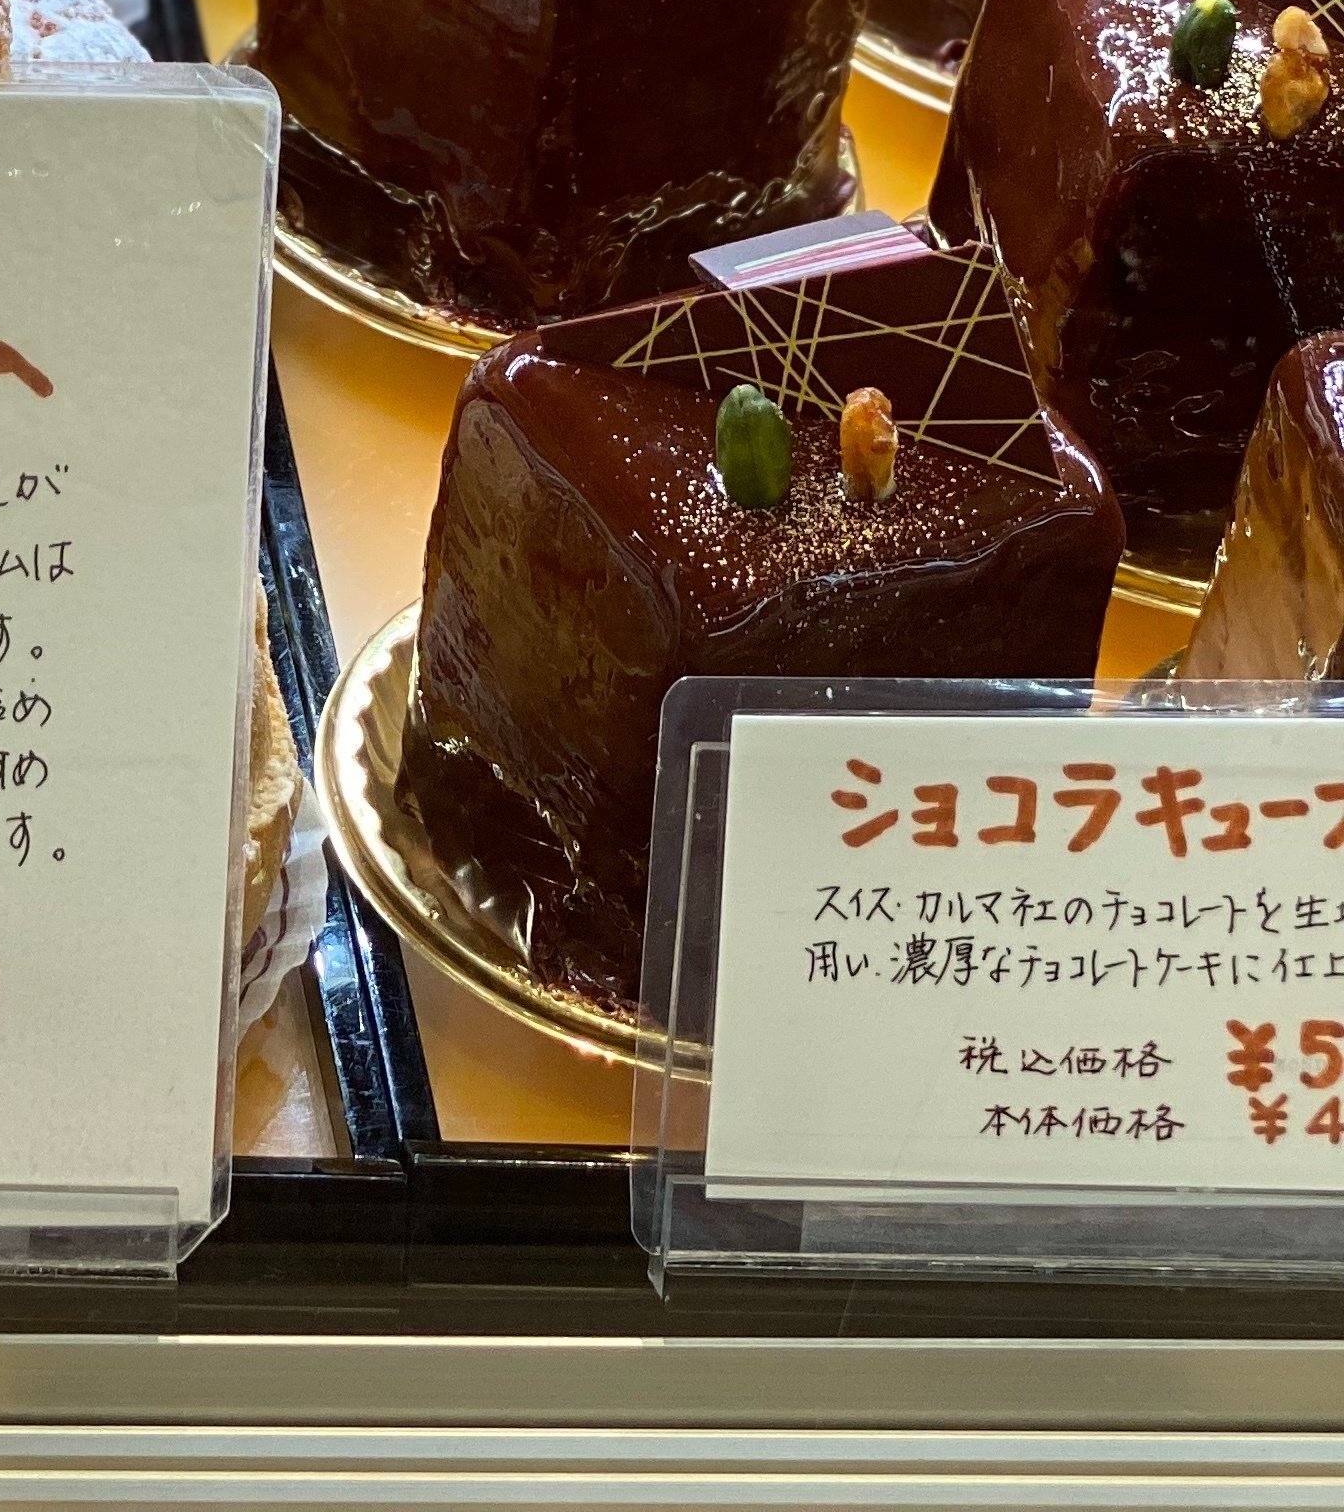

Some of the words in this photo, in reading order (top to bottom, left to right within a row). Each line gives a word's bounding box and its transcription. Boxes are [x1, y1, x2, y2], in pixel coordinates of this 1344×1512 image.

[959, 1036, 1173, 1079] 税込価格
[979, 1104, 1186, 1142] 本体価格
